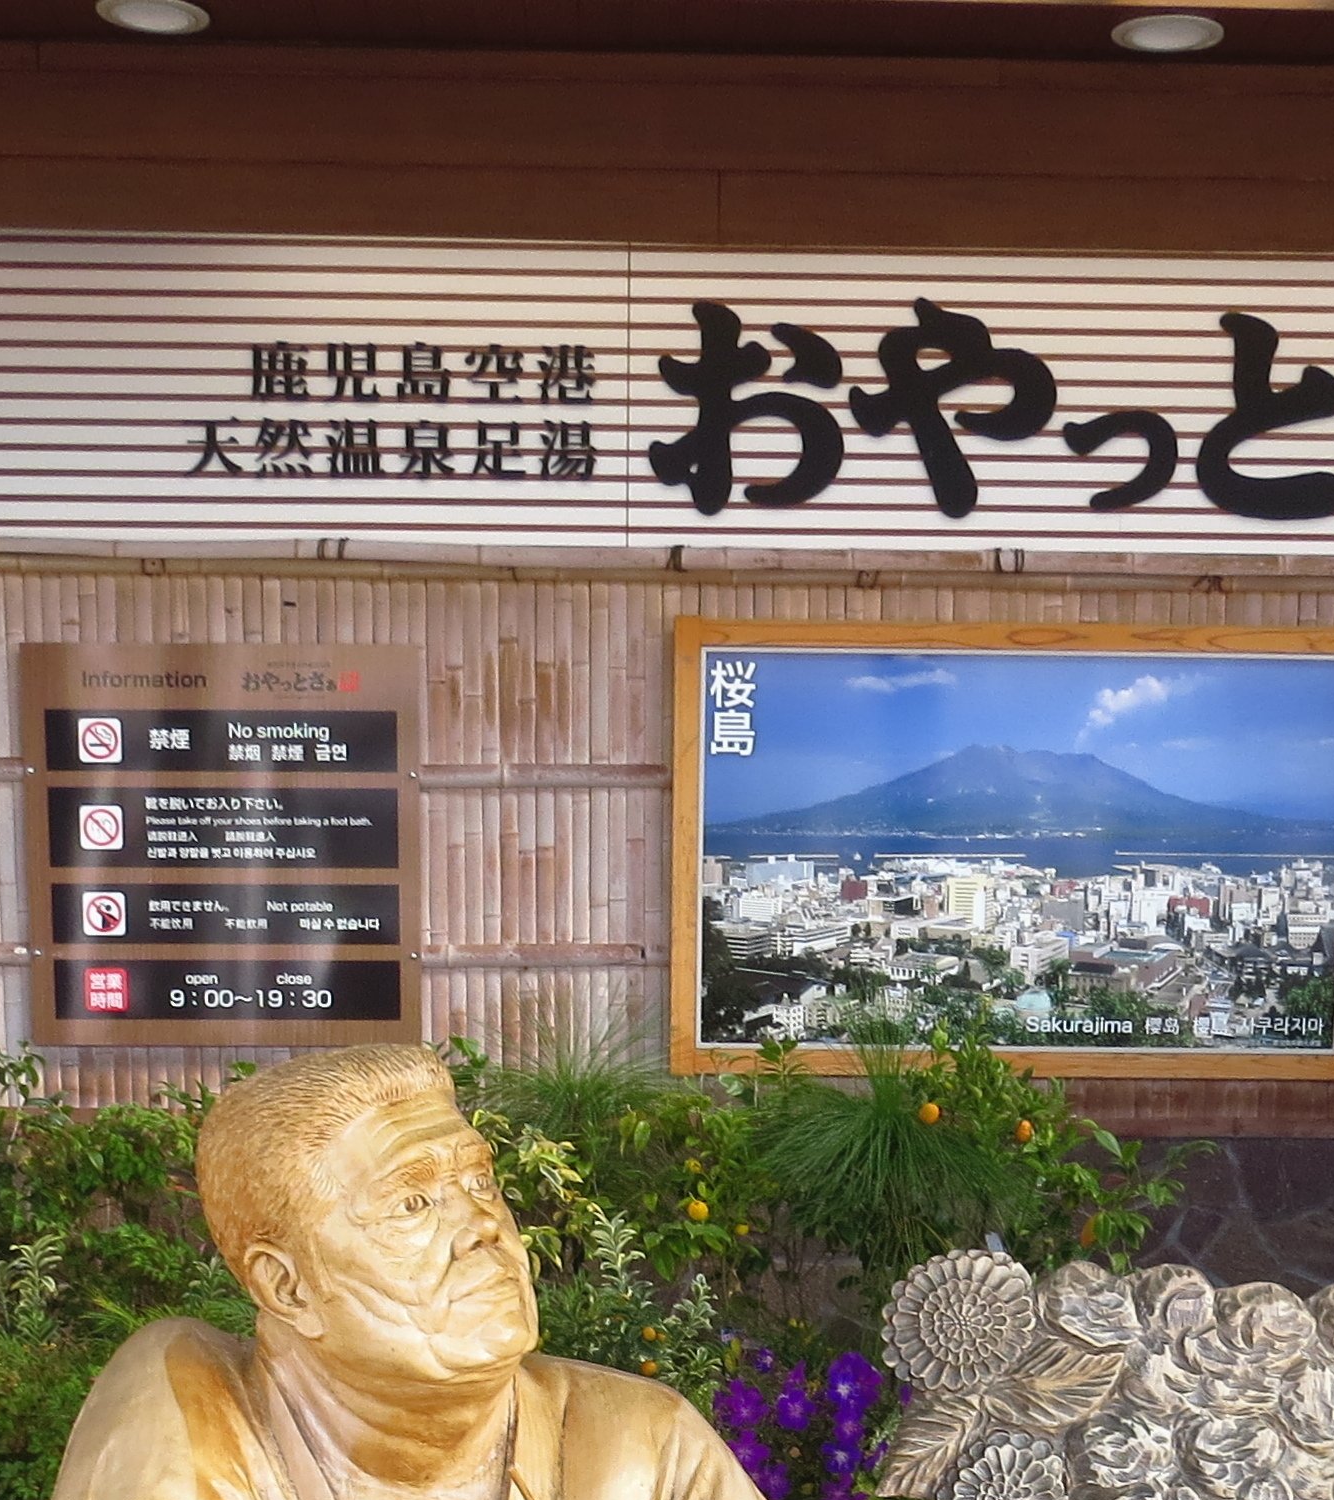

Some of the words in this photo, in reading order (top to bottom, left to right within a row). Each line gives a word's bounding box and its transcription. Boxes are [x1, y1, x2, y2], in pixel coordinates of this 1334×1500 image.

[251, 341, 596, 405] 鹿児島空港
[187, 417, 597, 480] 天然温泉足湯
[81, 670, 208, 688] Information
[241, 671, 337, 693] おやっとさぁ
[709, 659, 757, 756] 桜島
[148, 728, 191, 750] 禁煙
[228, 722, 253, 739] No
[256, 722, 330, 742] smoking
[314, 744, 348, 762] 금연
[145, 816, 176, 826] Please
[212, 816, 233, 828] your
[263, 816, 293, 826] before
[266, 900, 289, 913] Not
[290, 900, 334, 914] potable
[89, 972, 123, 990] 営業
[184, 973, 219, 987] open
[275, 972, 313, 986] close
[89, 991, 124, 1010] 時間
[1025, 1015, 1134, 1036] Sakurajima
[1240, 1015, 1325, 1036] 사쿠라지마
